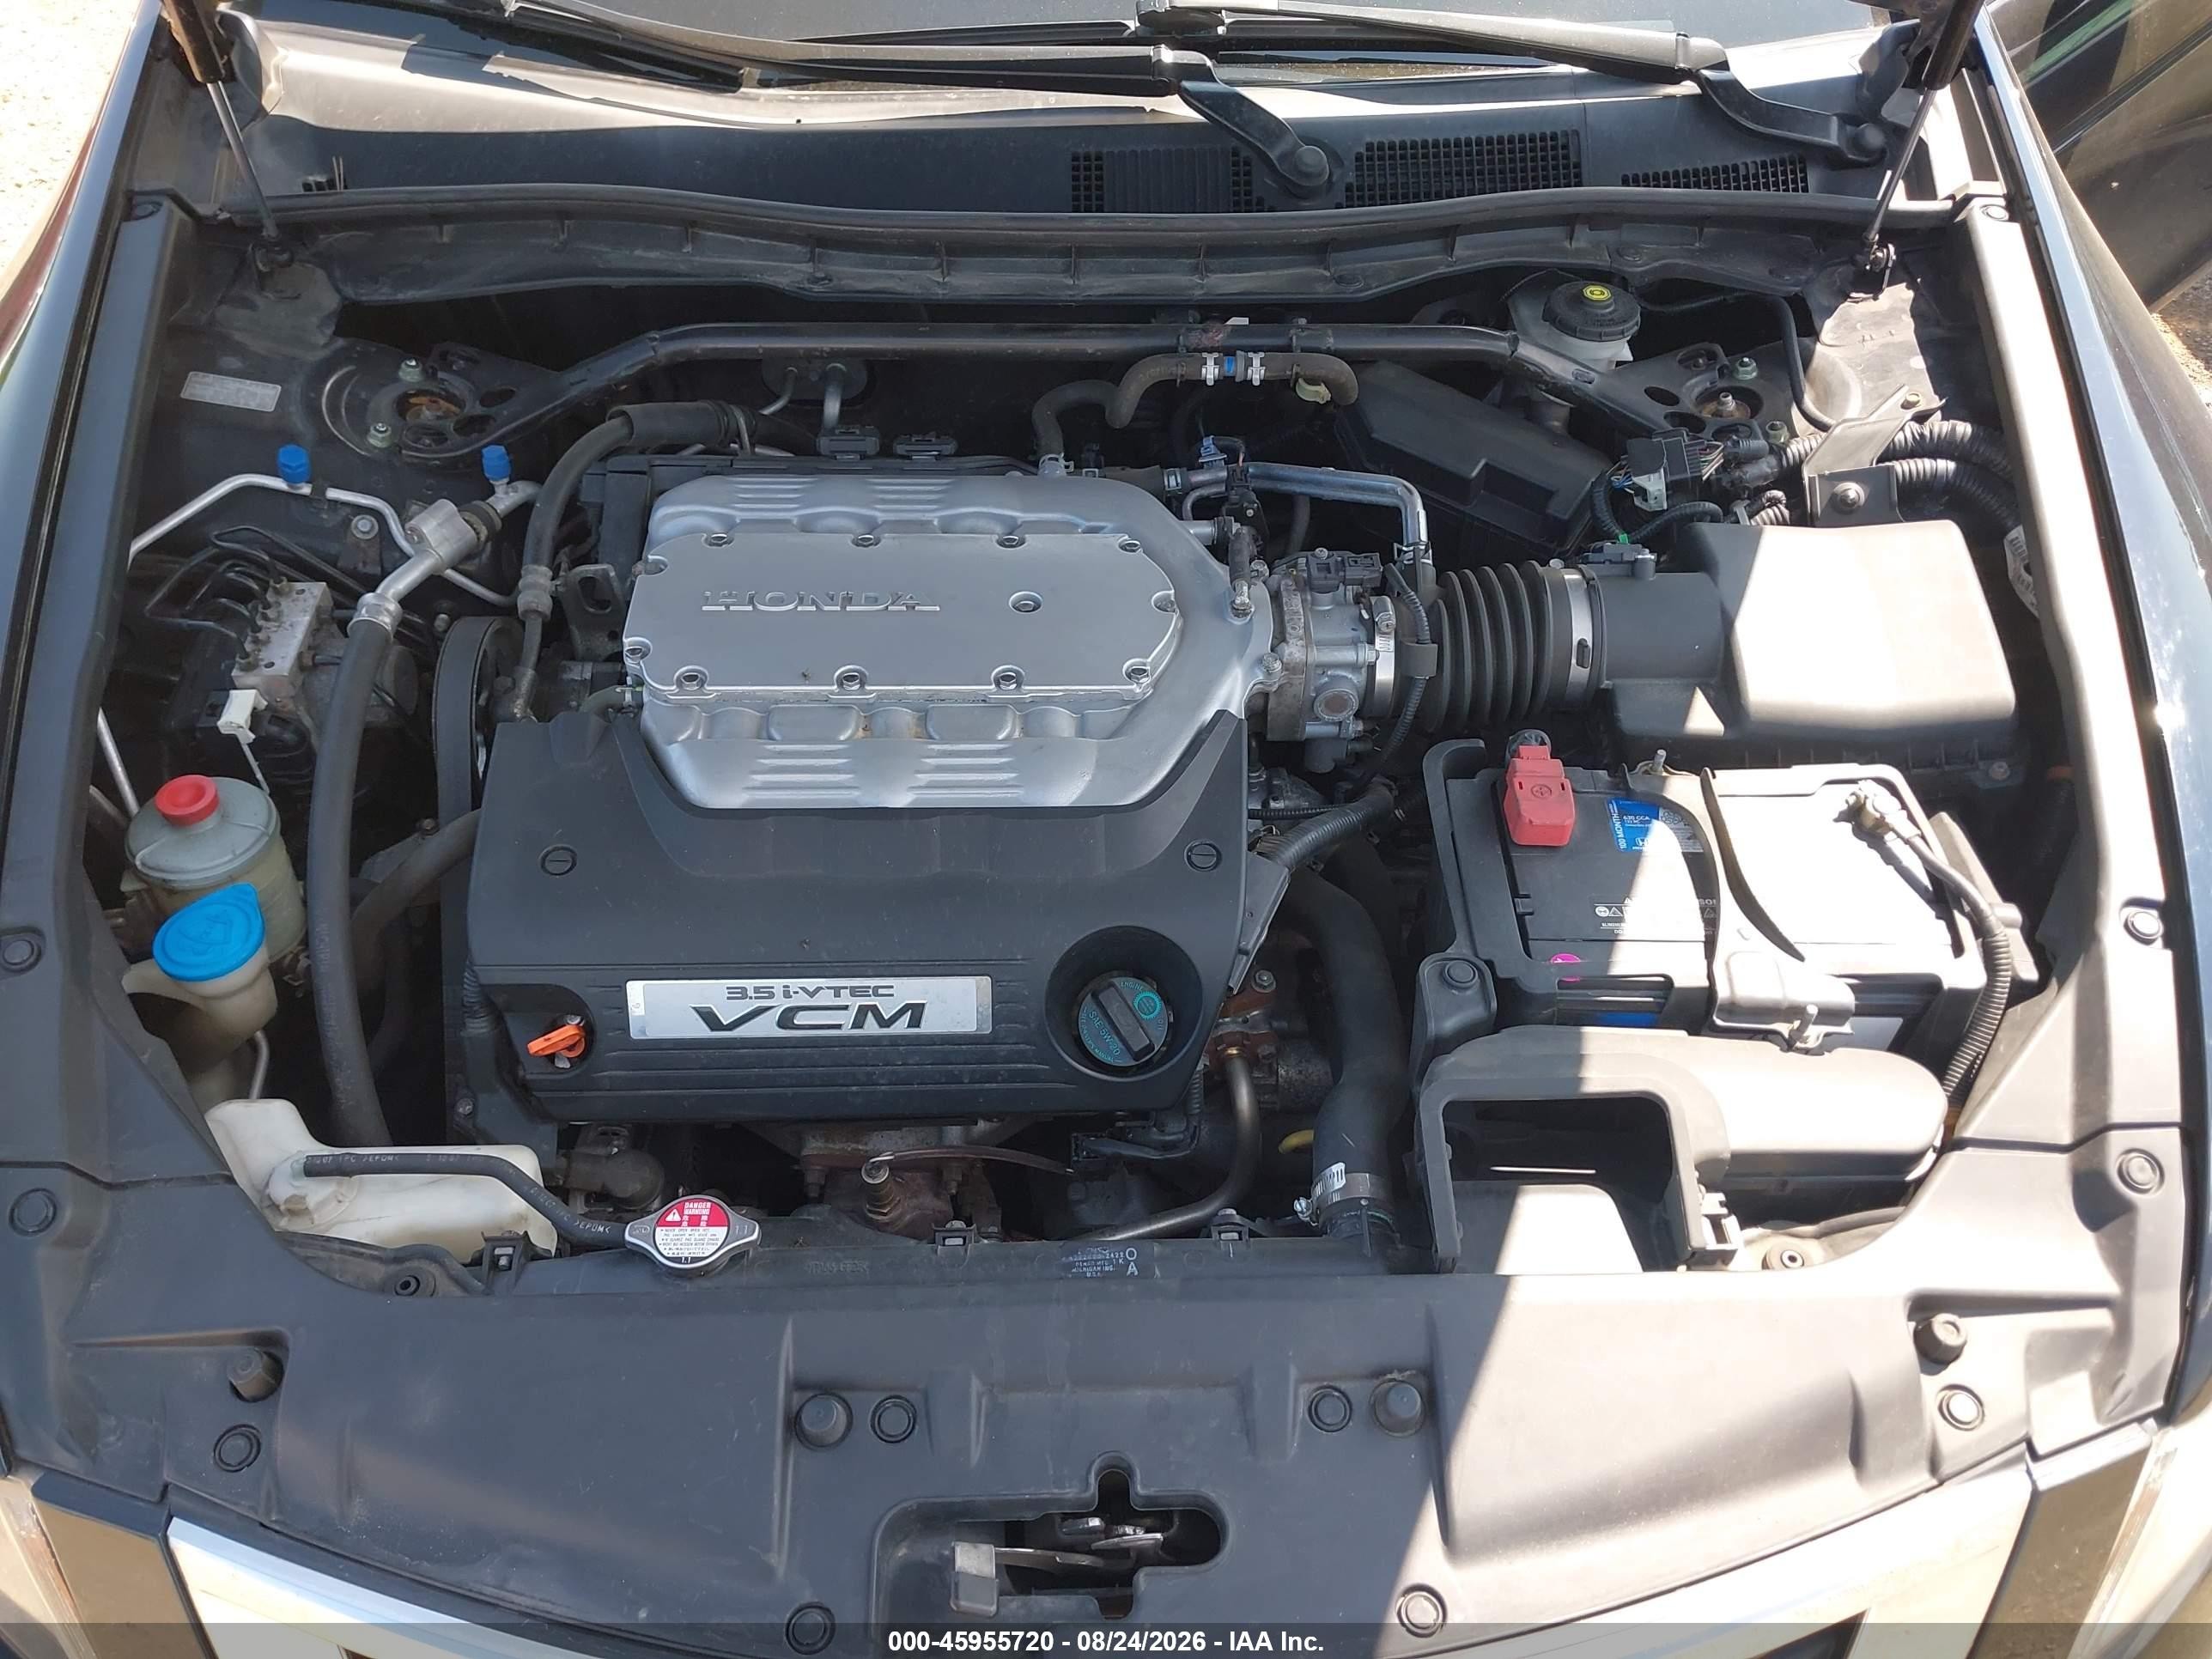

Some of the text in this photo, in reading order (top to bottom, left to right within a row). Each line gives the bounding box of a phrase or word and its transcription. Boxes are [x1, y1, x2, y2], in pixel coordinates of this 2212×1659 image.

[702, 591, 941, 611] HONDA
[1612, 813, 1625, 837] MONTH
[726, 984, 895, 1000] 3.5 i-VTEC
[690, 1000, 928, 1032] VCM
[1089, 1011, 1121, 1055] SAE 5W-20
[1126, 1261, 1139, 1277] A
